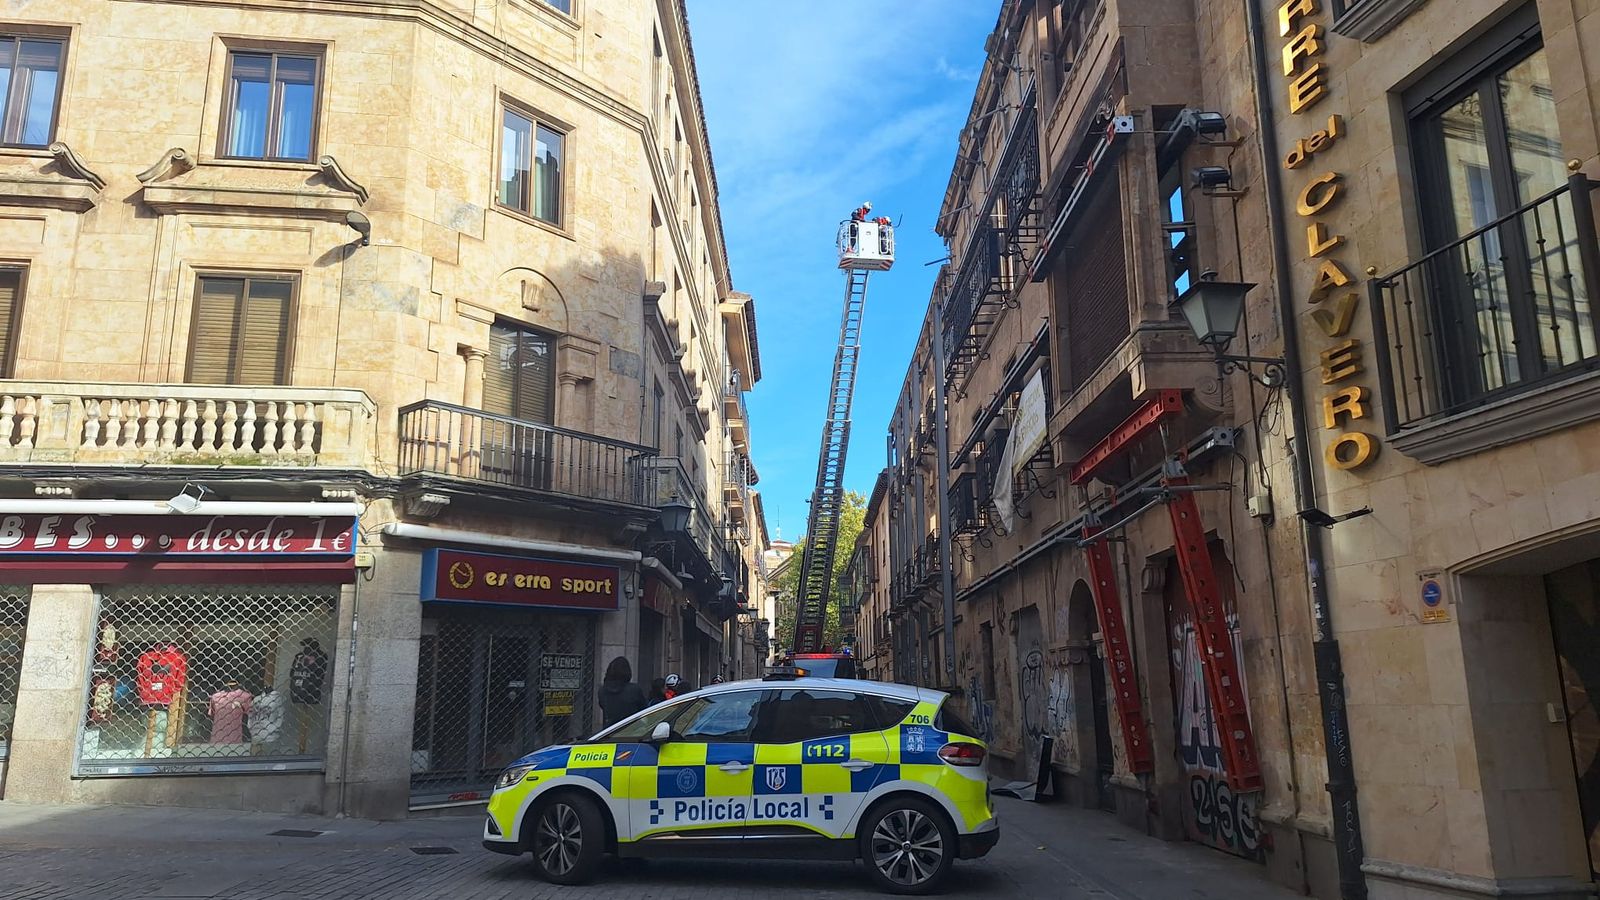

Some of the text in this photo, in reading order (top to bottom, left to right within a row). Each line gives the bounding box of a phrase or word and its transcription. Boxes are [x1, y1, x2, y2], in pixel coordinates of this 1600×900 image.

[1283, 114, 1343, 169] del
[1296, 171, 1376, 471] CLAVERO
[187, 515, 294, 551] desde
[561, 577, 613, 594] sport
[542, 655, 582, 669] SE VENDE
[910, 714, 930, 725] 706
[812, 744, 846, 758] 112
[674, 797, 809, 822] Policía Local
